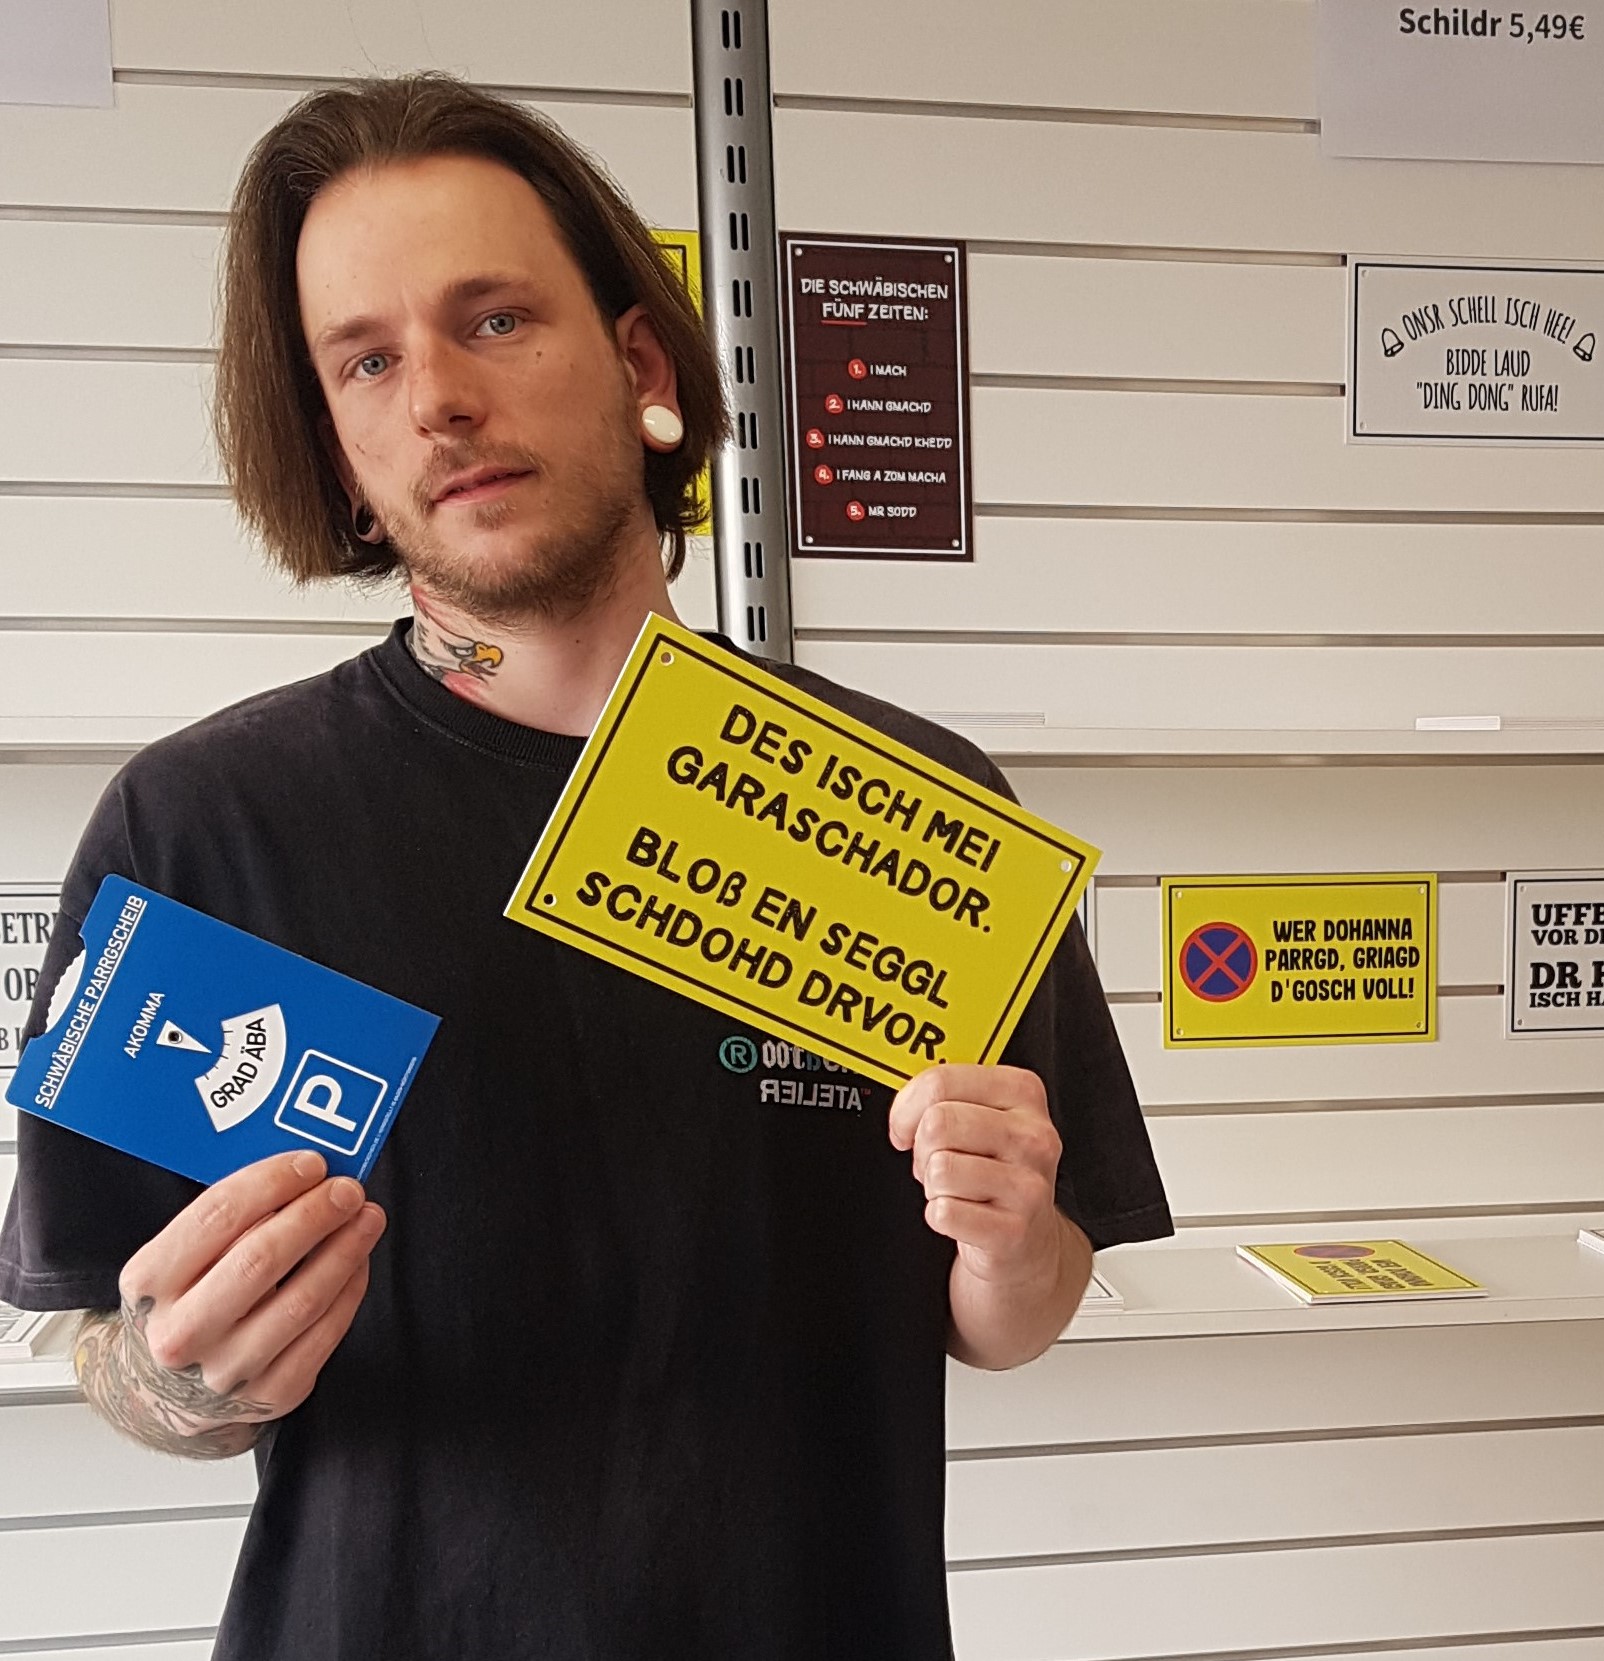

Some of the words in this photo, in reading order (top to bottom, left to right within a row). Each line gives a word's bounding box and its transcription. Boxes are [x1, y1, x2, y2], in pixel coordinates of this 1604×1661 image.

[1399, 8, 1502, 37] Schildr
[1509, 13, 1585, 44] 5,49€
[800, 278, 825, 294] DIE
[828, 276, 948, 299] SCHWÄBISCHEN
[822, 298, 864, 319] FÜNF
[867, 303, 929, 321] ZEITEN:
[1402, 303, 1445, 341] ONSR
[1448, 295, 1497, 327] SCHELL
[1504, 297, 1540, 331] ISCH
[1543, 308, 1576, 344] HEE!
[875, 364, 907, 376] MACH
[1446, 349, 1487, 376] BIDDE
[1494, 350, 1531, 377] LAUD
[852, 400, 883, 411] HANN
[885, 401, 931, 413] GMACHD
[1416, 382, 1461, 410] "DING
[1468, 383, 1514, 411] DONG"
[1521, 384, 1559, 412] RUFA!
[833, 434, 864, 446] HANN
[866, 436, 912, 448] GMACHD
[914, 437, 952, 448] KHEDD
[842, 470, 871, 481] FANG
[873, 470, 882, 481] A
[883, 470, 906, 482] ZOM
[908, 472, 946, 484] MACHA
[868, 506, 884, 516] MR
[887, 506, 917, 518] SODD
[720, 704, 813, 775] DES
[816, 754, 923, 832] ISCH
[921, 810, 1002, 873] MEI
[666, 745, 992, 934] GARASCHADOR.
[1272, 920, 1316, 942] WER
[1323, 918, 1413, 942] DOHANNA
[1531, 928, 1578, 946] VOR
[751, 886, 816, 942] EN
[820, 922, 949, 1009] SEGGL
[1265, 948, 1345, 971] PARRGD,
[1352, 946, 1420, 969] GRIAGD
[576, 871, 794, 990] SCHDOHD
[797, 969, 947, 1065] DRVOR.
[1530, 962, 1582, 989] DR
[34, 998, 95, 1108] SCHWÄBISCHE
[84, 895, 143, 1000] PARRGSCHEIB
[1271, 978, 1355, 1002] D'GOSCH
[1362, 977, 1414, 1000] VOLL!
[1529, 992, 1581, 1008] ISCH
[124, 992, 165, 1059] AKOMMA
[209, 1061, 258, 1109] GRAD
[240, 1017, 267, 1062] ÄBA
[293, 1074, 357, 1133] P
